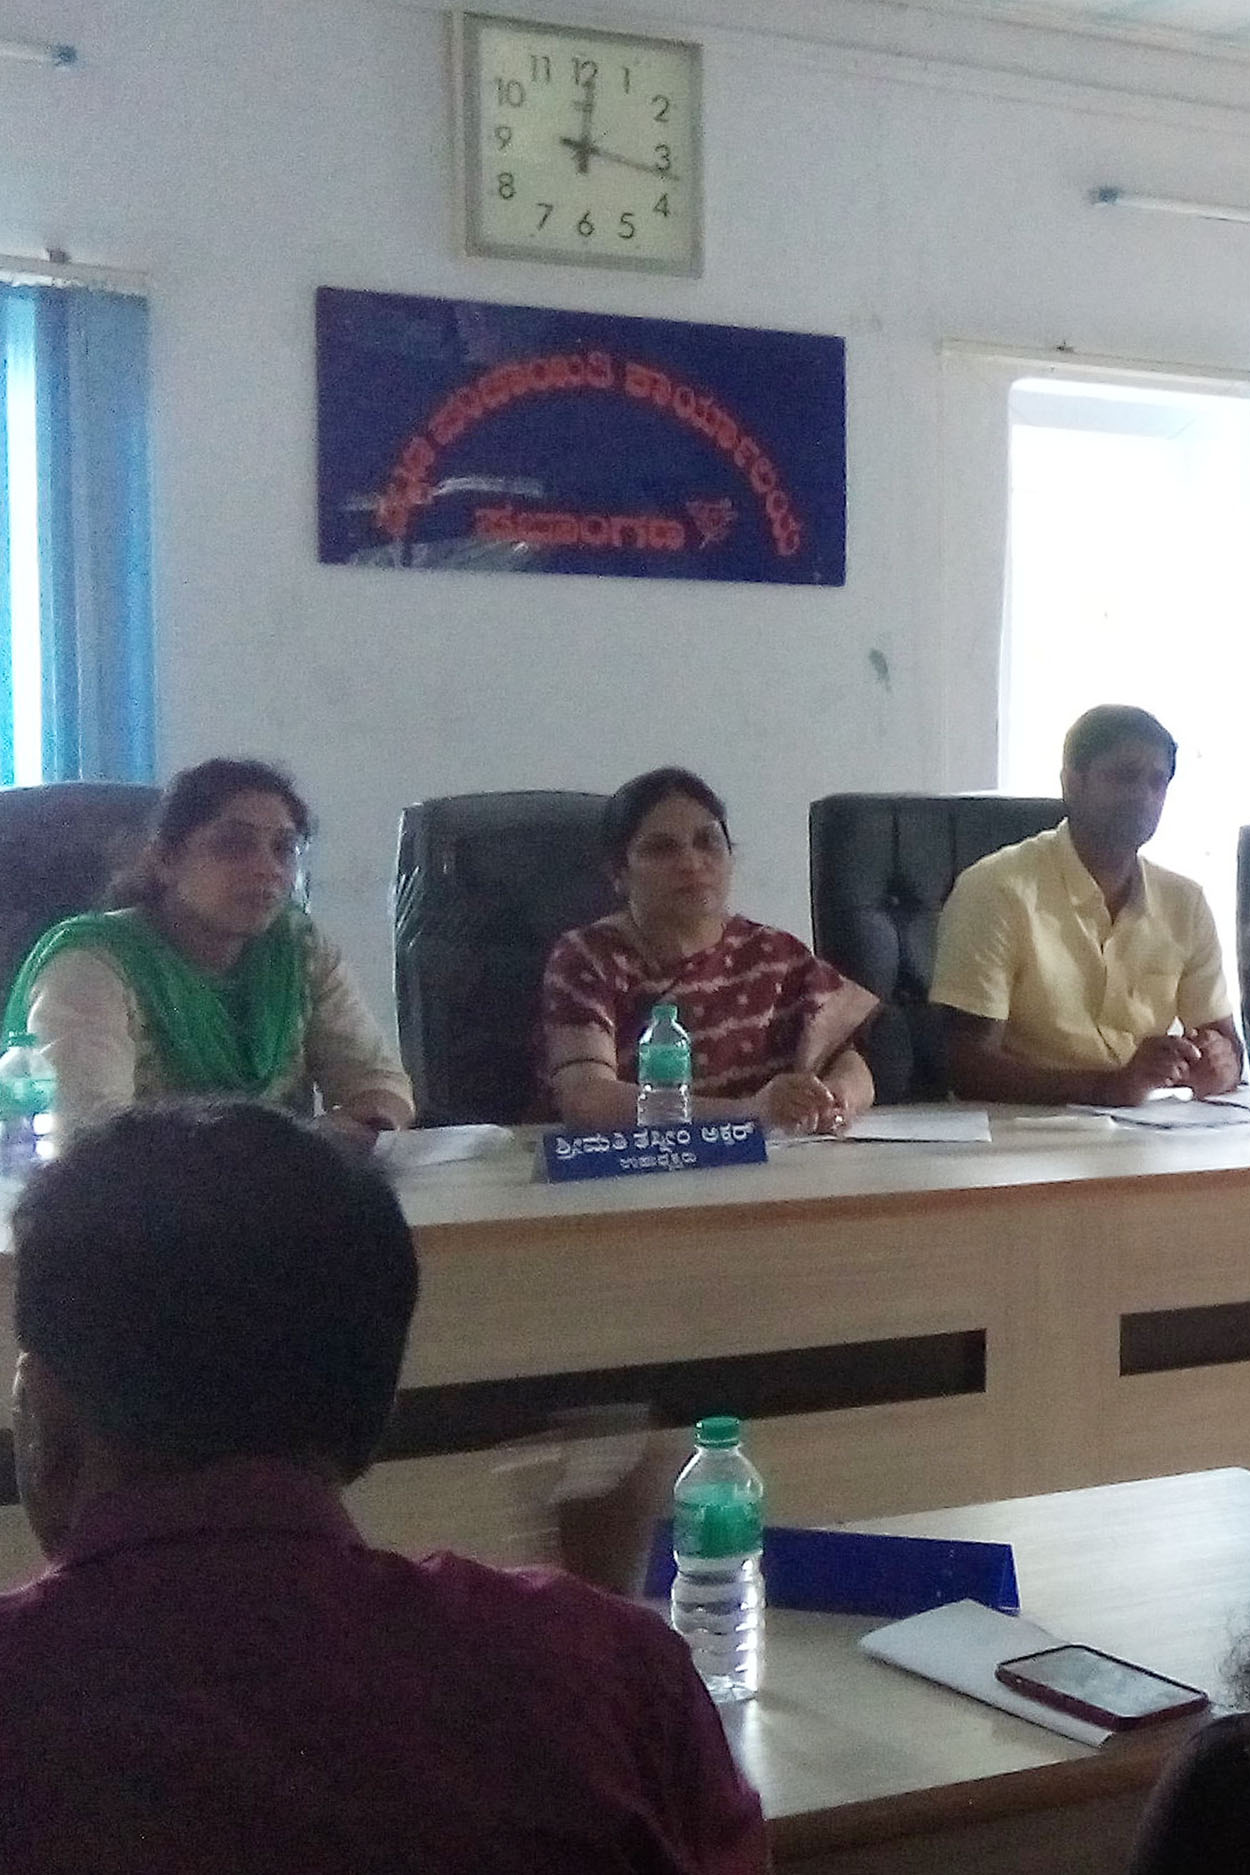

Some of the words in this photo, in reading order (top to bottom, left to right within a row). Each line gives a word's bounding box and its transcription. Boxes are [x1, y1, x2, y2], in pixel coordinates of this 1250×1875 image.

[531, 55, 550, 84] 11
[572, 57, 598, 89] 12
[495, 78, 526, 108] 10
[651, 95, 670, 122] 2
[495, 126, 512, 152] 9
[654, 144, 671, 172] 3
[498, 172, 516, 200] 8
[536, 203, 554, 231] 7
[653, 192, 670, 218] 4
[577, 210, 595, 237] 6
[617, 212, 636, 240] 5
[555, 1133, 628, 1160] ಶ್ರೀಮತಿ
